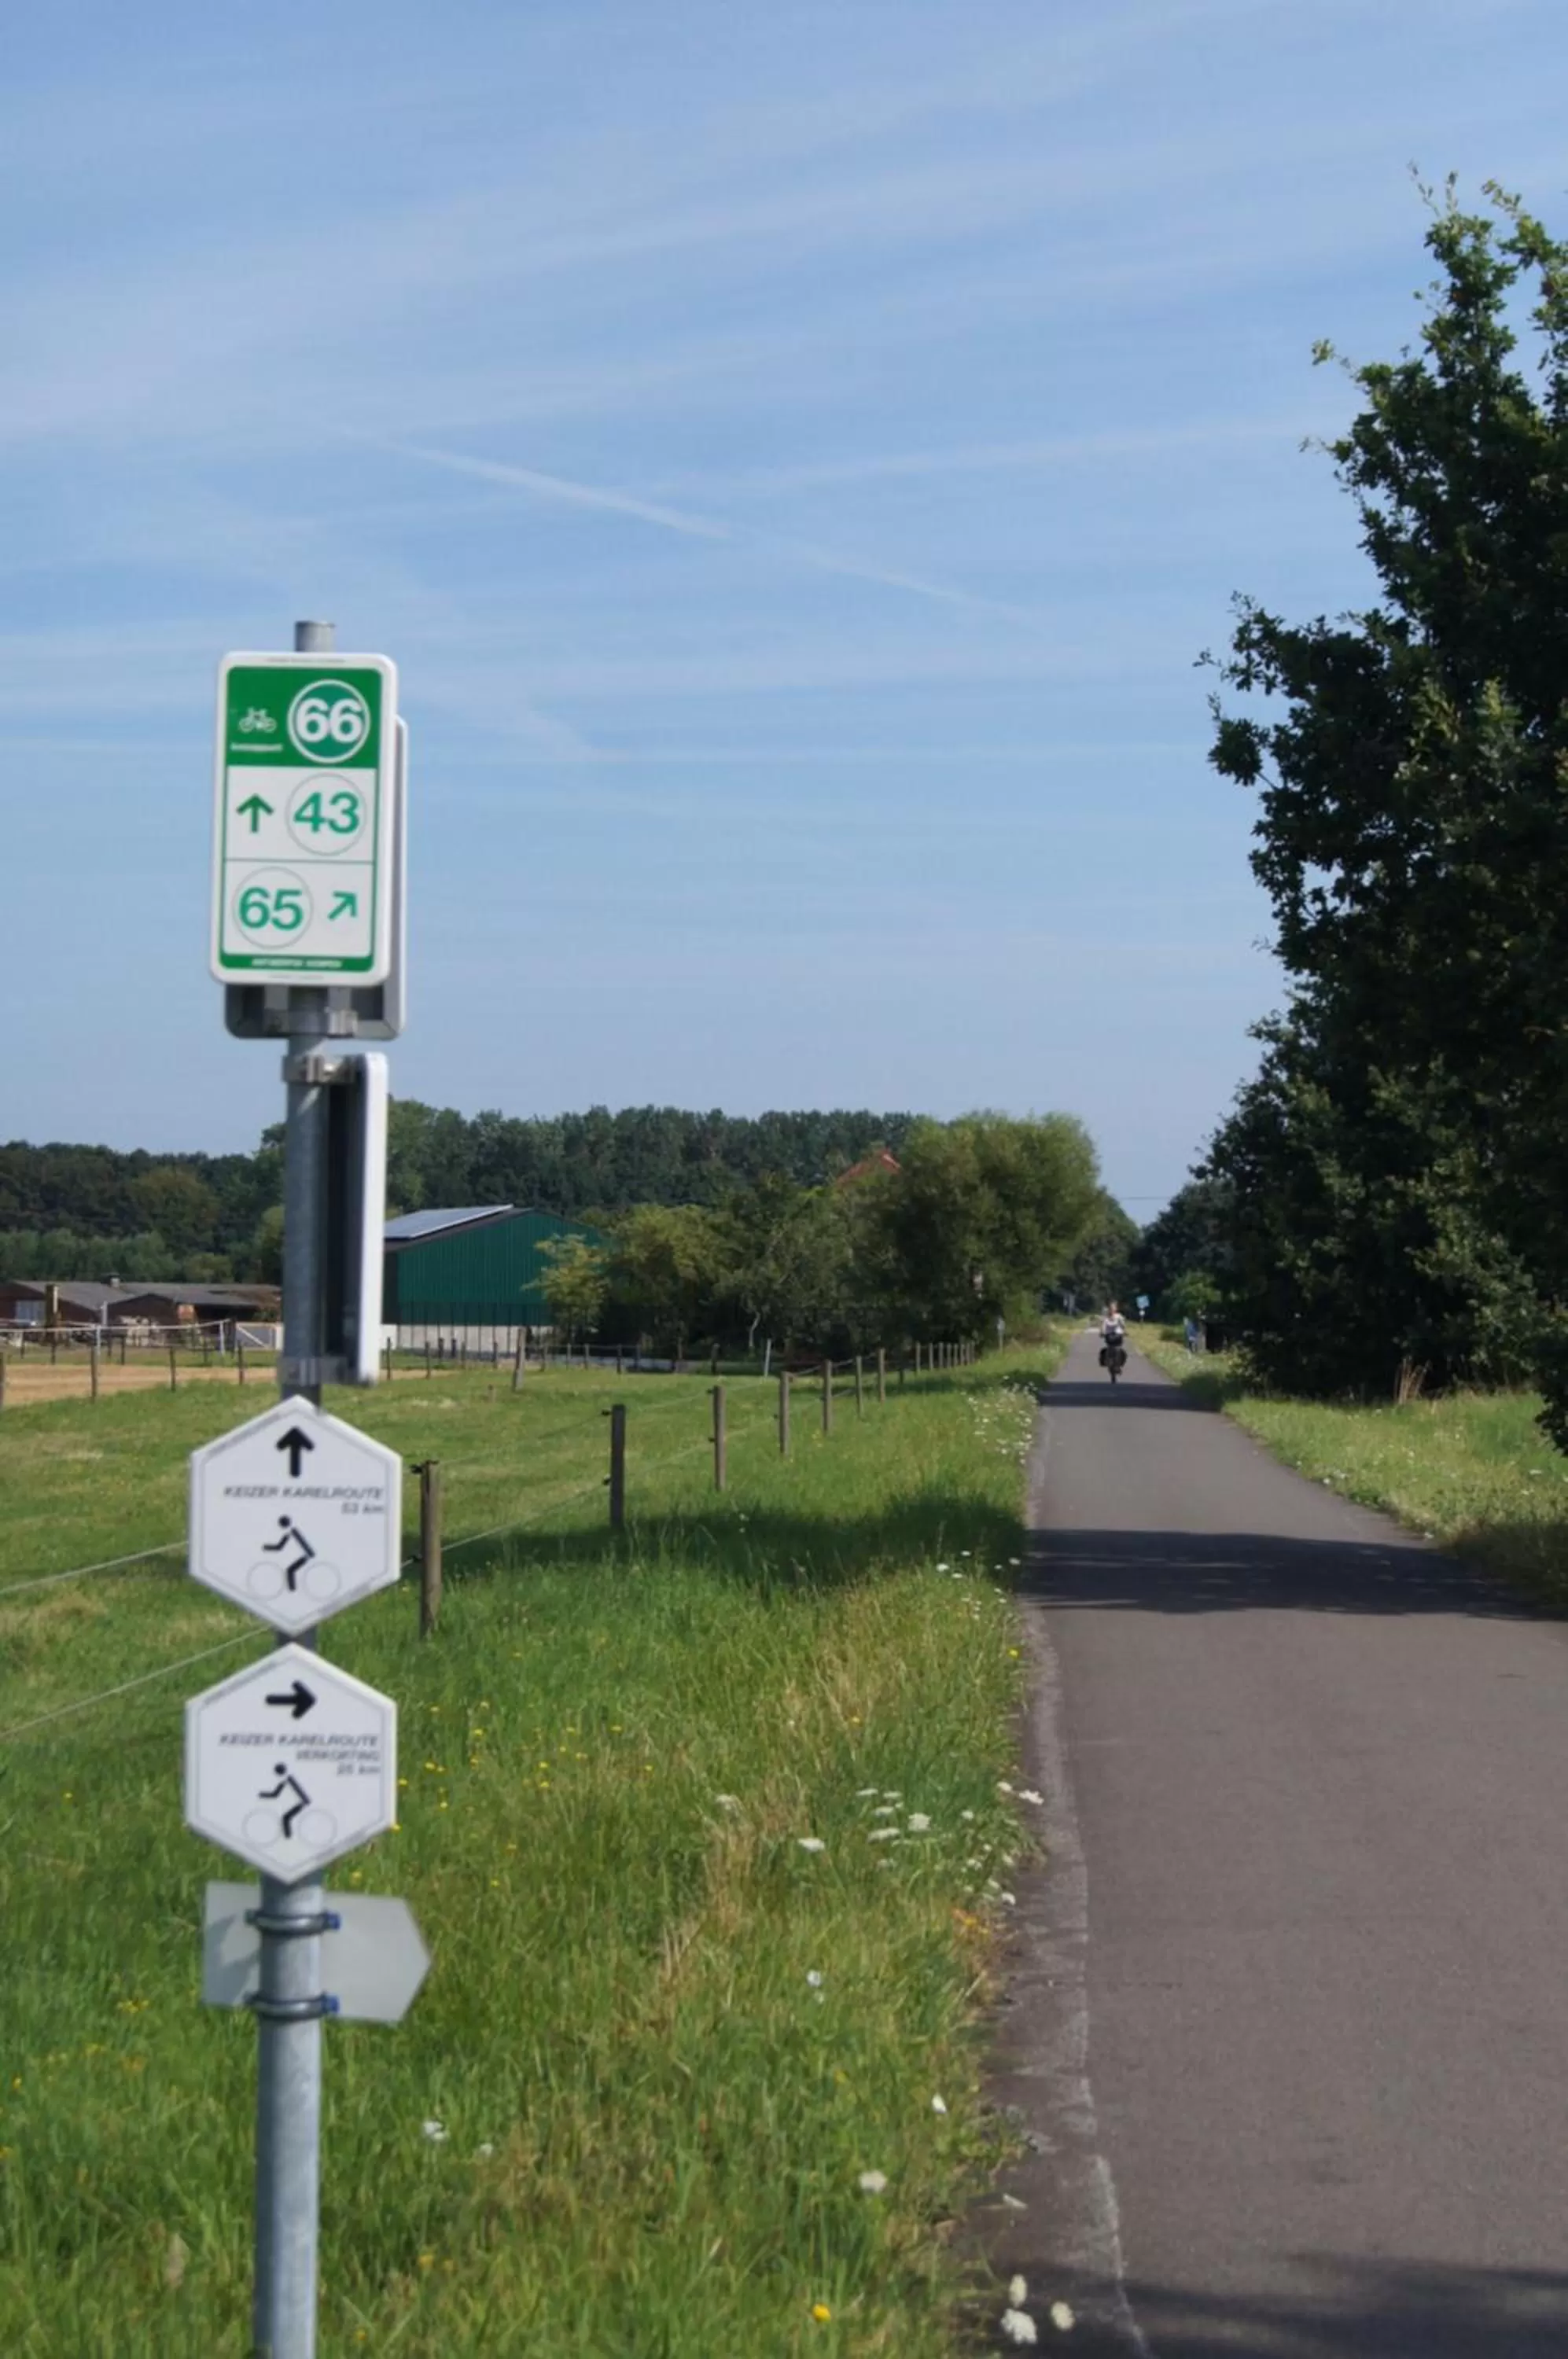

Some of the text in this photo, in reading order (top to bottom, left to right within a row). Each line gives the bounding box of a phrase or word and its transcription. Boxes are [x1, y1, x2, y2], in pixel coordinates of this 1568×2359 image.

[296, 697, 363, 743] 66
[293, 791, 360, 834] 43
[238, 886, 304, 931] 65
[223, 1485, 278, 1497] KEIZER
[219, 1733, 274, 1746] KEIZER
